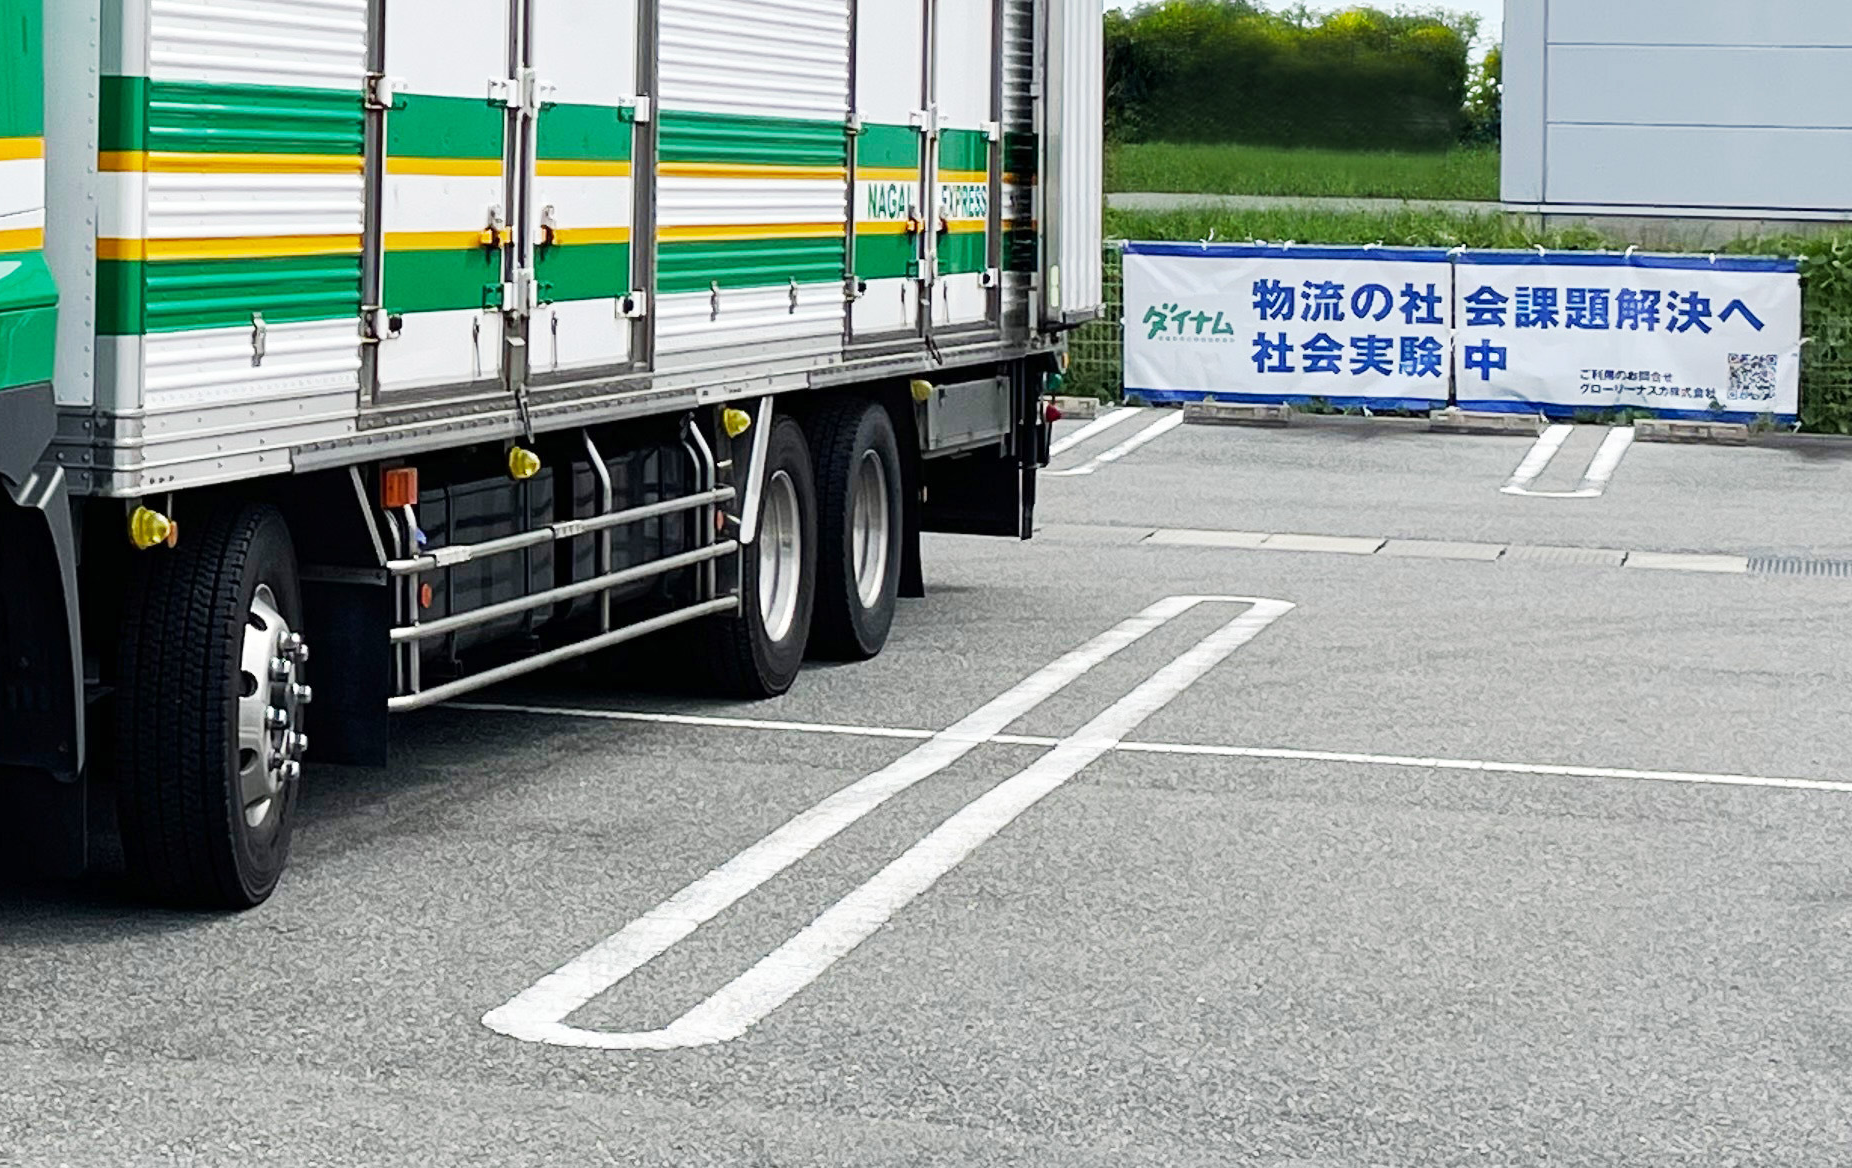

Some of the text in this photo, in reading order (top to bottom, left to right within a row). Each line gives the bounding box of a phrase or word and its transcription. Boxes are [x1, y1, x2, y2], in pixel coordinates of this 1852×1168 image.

[867, 183, 987, 220] NAGAI EXPRESS
[1142, 302, 1235, 340] ダイナム
[1252, 278, 1765, 333] 物流の社会課題解決へ
[1251, 331, 1508, 381] 社会実験中
